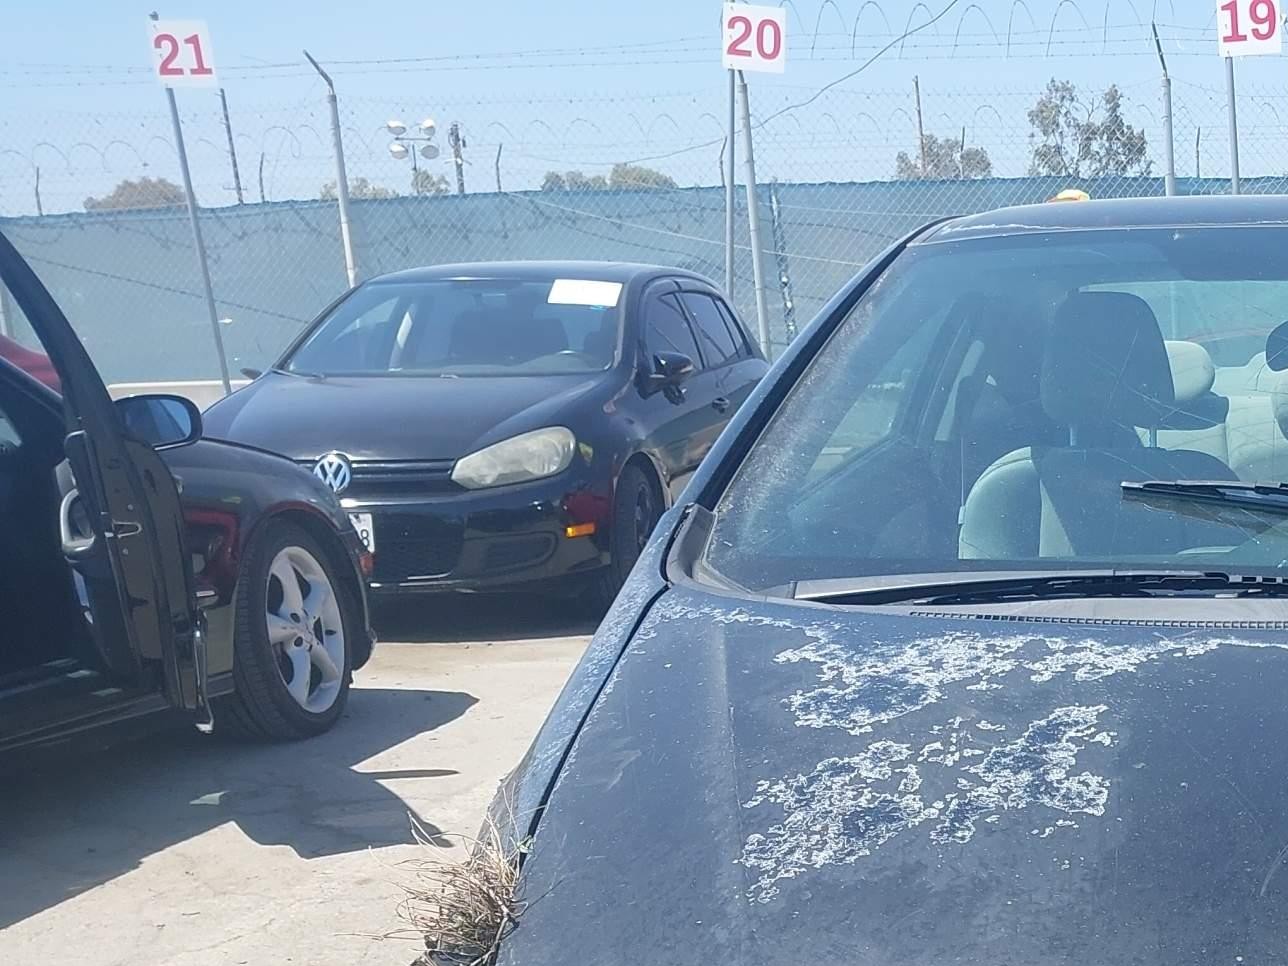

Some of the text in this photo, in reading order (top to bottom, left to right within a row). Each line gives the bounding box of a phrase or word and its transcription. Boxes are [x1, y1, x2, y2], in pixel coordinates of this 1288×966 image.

[727, 16, 781, 60] 20
[1221, 0, 1276, 42] 19
[154, 34, 213, 76] 21
